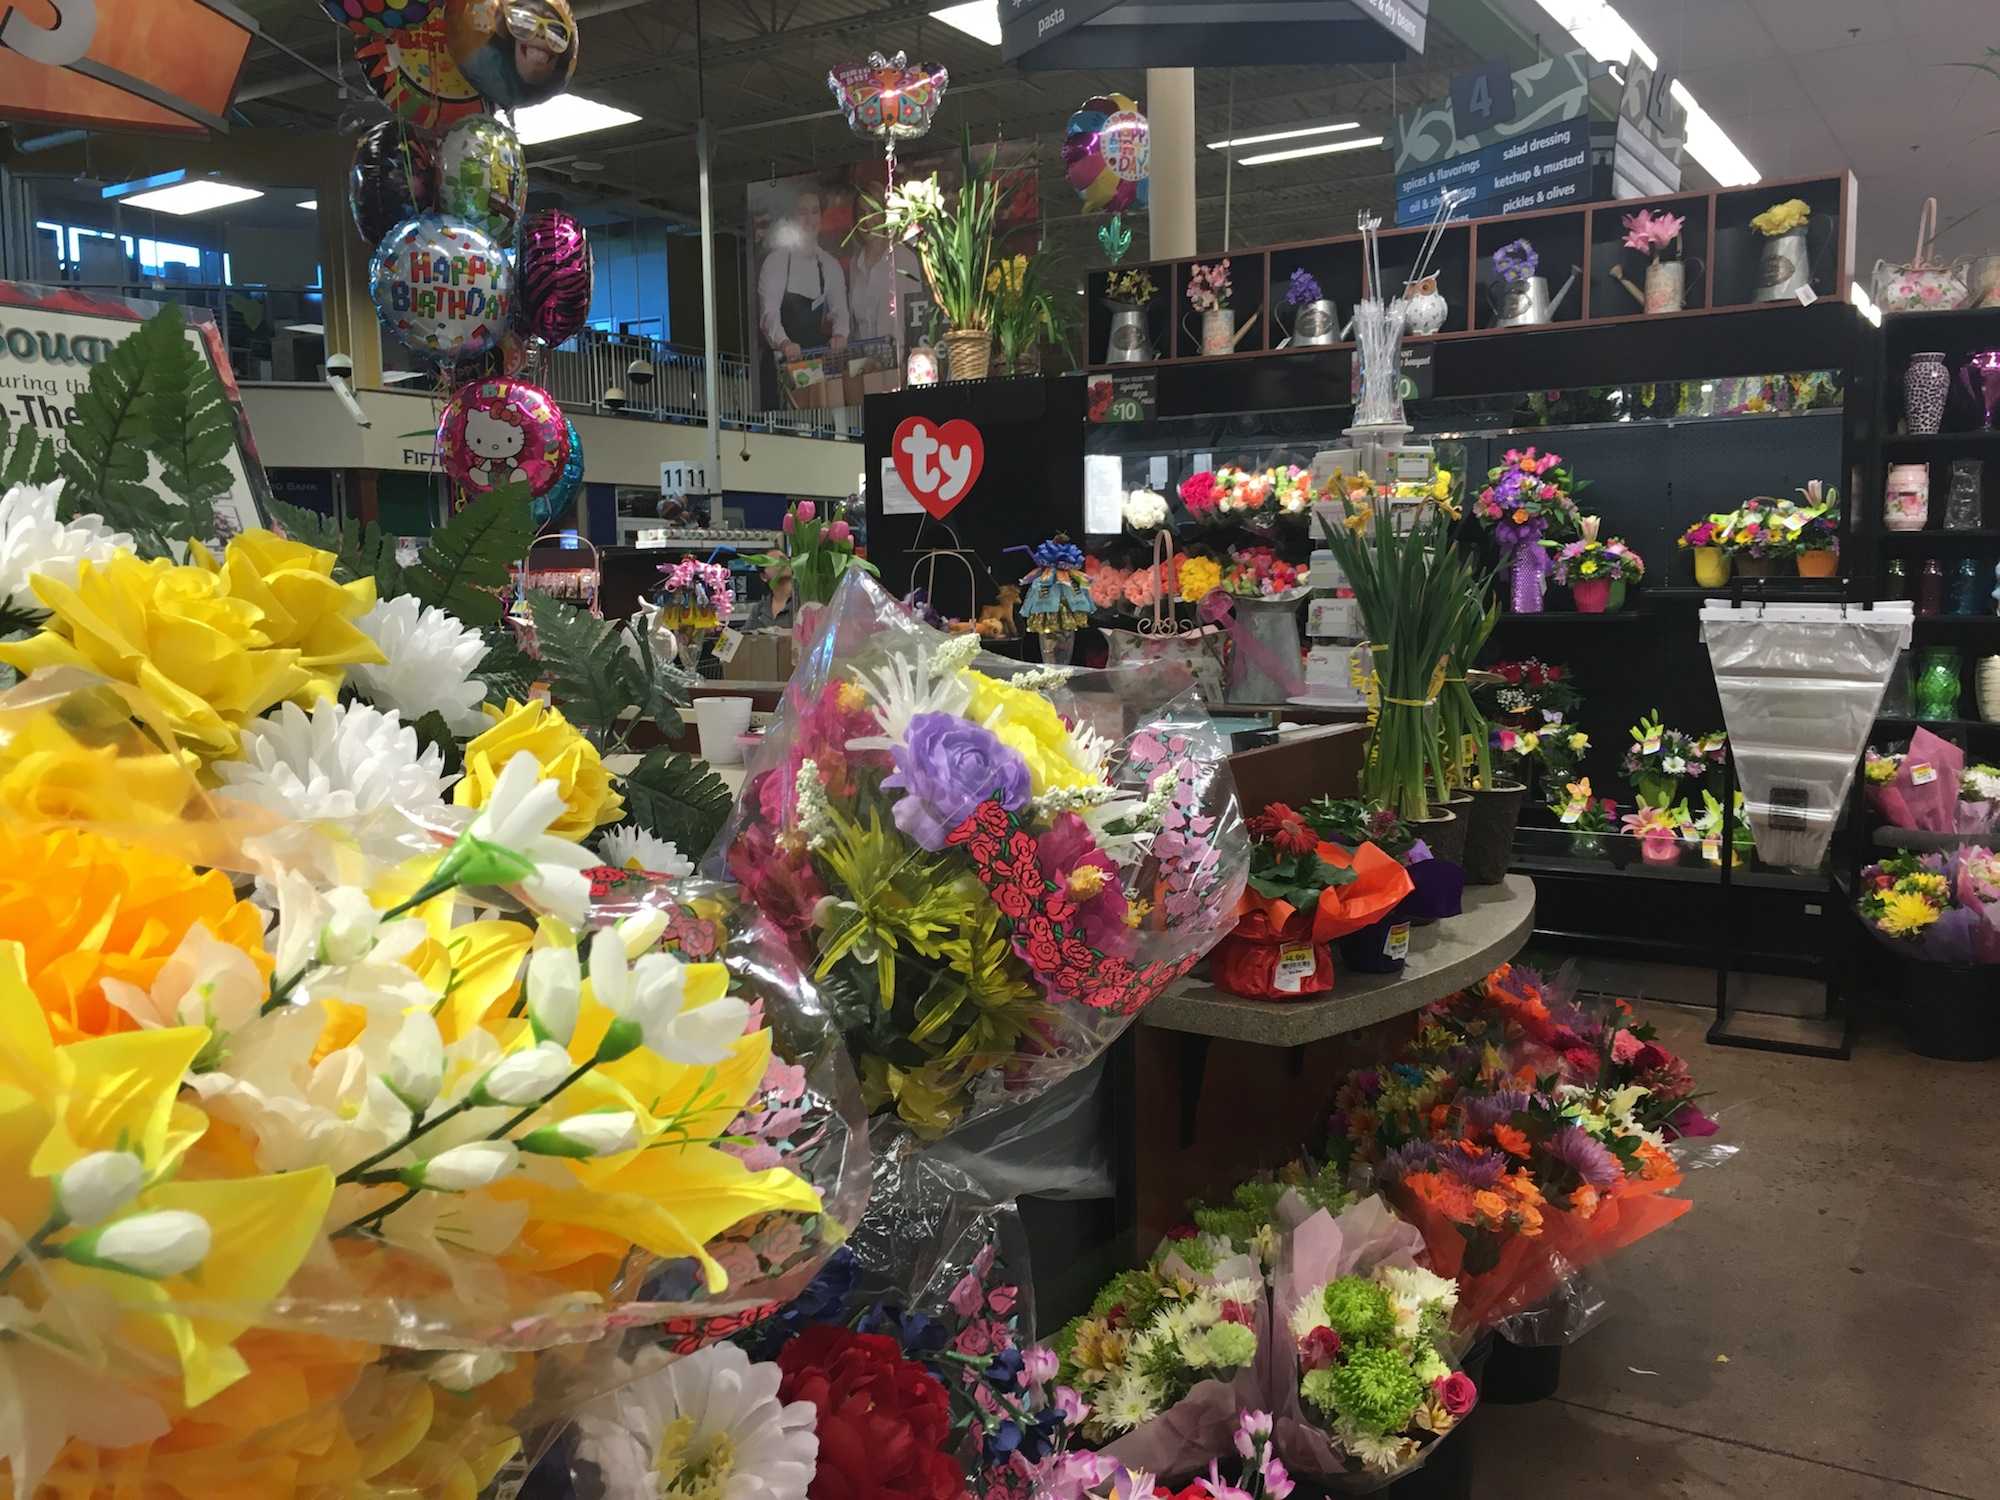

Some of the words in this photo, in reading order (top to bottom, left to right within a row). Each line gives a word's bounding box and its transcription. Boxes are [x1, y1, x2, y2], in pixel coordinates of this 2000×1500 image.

[1037, 8, 1065, 38] pasta
[1397, 7, 1417, 38] beans
[1469, 75, 1493, 119] 4
[1502, 142, 1528, 161] salad
[1529, 130, 1571, 152] dressing
[1402, 174, 1427, 193] spices
[1428, 171, 1436, 184] &
[1436, 158, 1481, 182] flavorings
[1494, 170, 1532, 189] ketchup
[1532, 165, 1542, 177] &
[1543, 151, 1585, 175] mustard
[1409, 200, 1421, 213] oil
[1422, 198, 1429, 210] &
[1502, 195, 1535, 215] pickles
[1535, 191, 1546, 203] &
[1546, 183, 1576, 200] olives
[409, 252, 501, 290] HAPPY
[391, 281, 510, 321] BIRTHDAY
[1112, 402, 1137, 421] $10
[901, 423, 973, 501] ty
[664, 468, 682, 488] 11
[688, 469, 705, 488] 11
